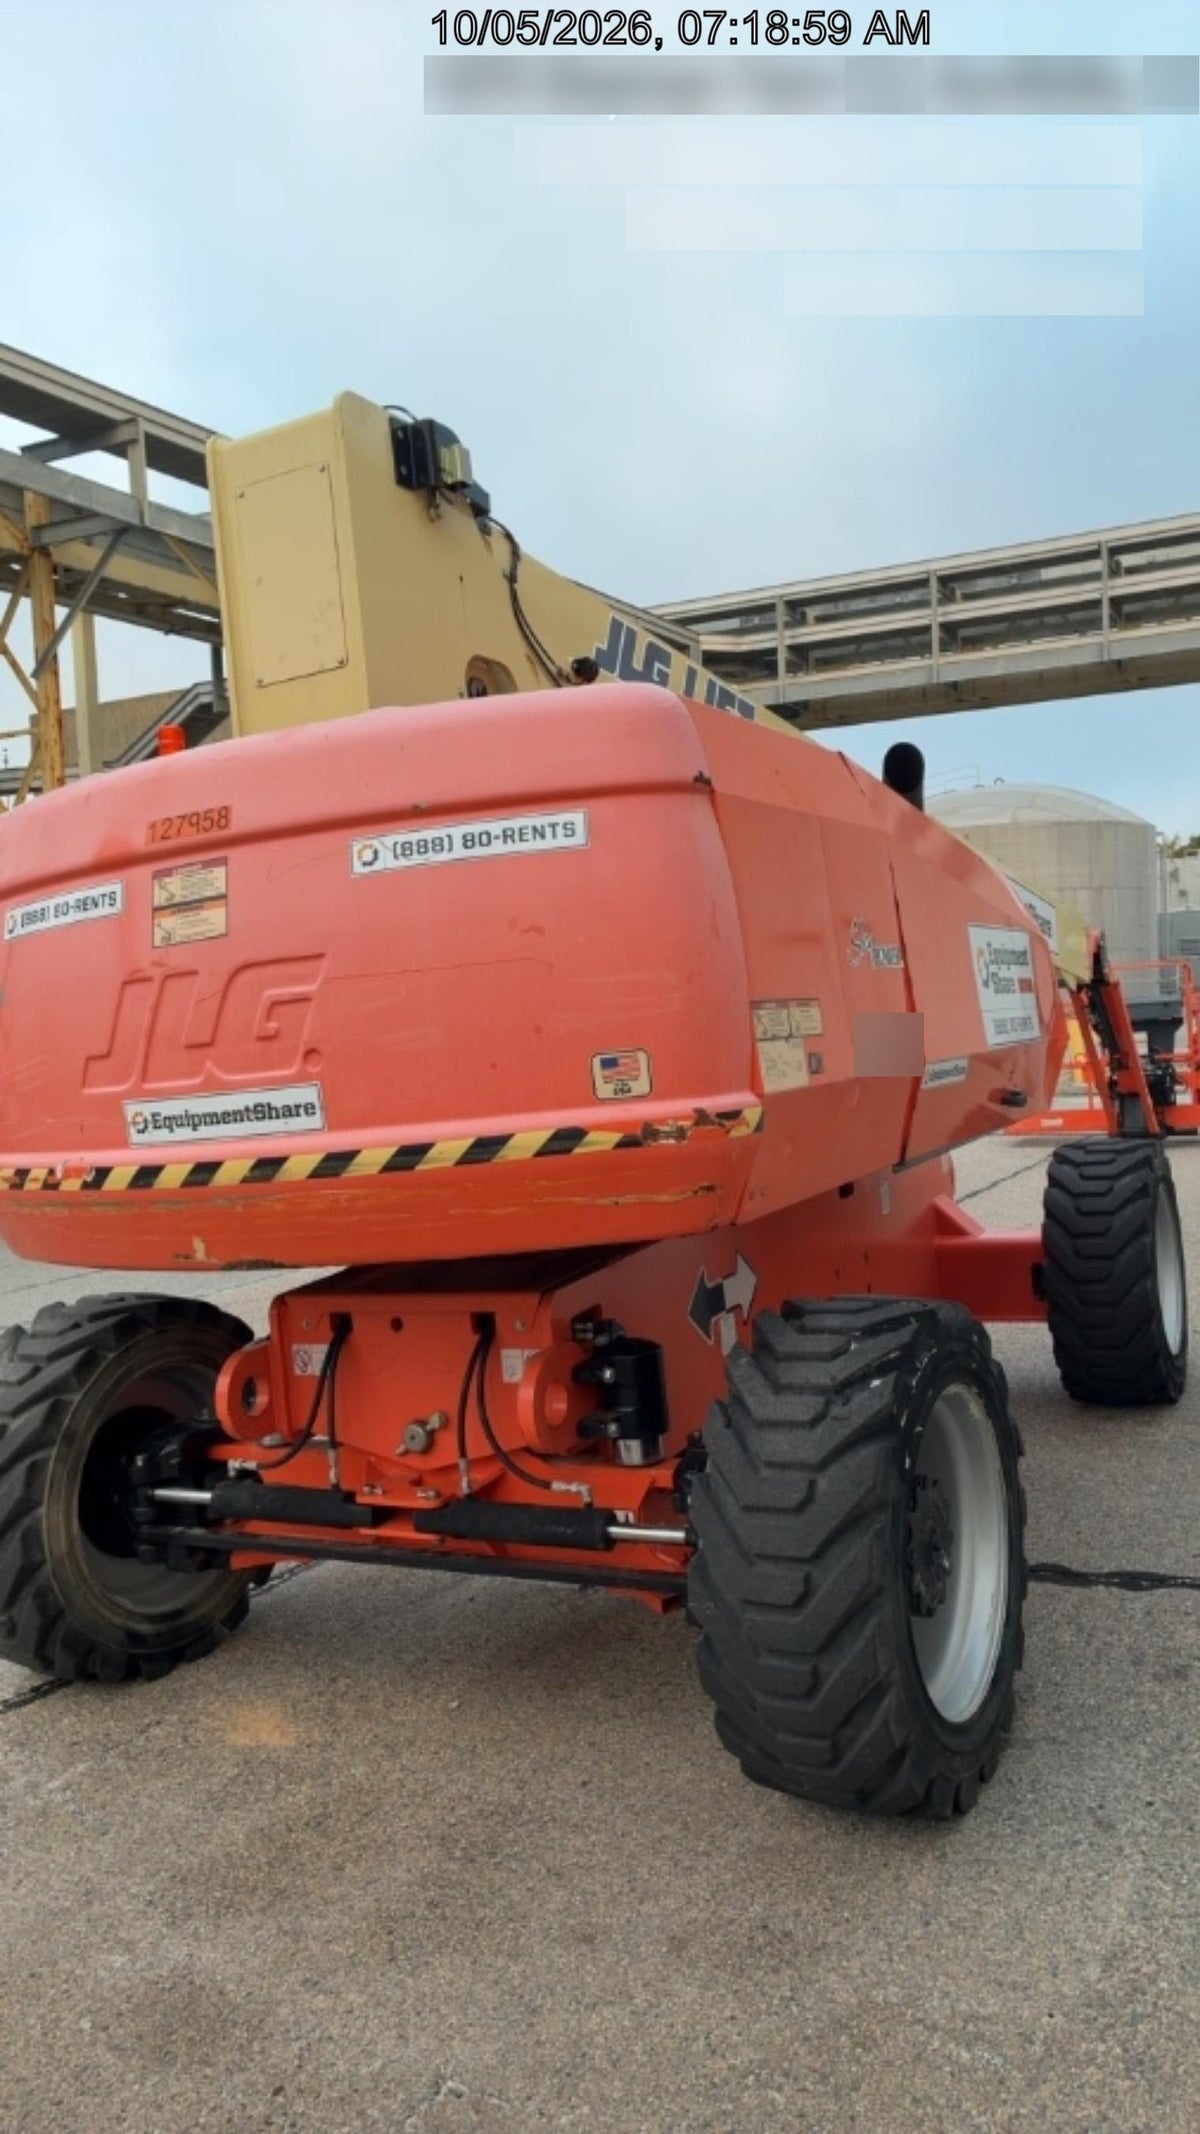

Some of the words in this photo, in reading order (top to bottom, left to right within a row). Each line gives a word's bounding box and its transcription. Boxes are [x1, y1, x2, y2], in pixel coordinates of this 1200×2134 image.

[593, 615, 673, 687] JLG
[149, 806, 229, 842] 127958
[392, 834, 453, 860] (888)
[461, 820, 577, 850] 80-RENTS
[151, 1101, 316, 1133] EquipmentShare
